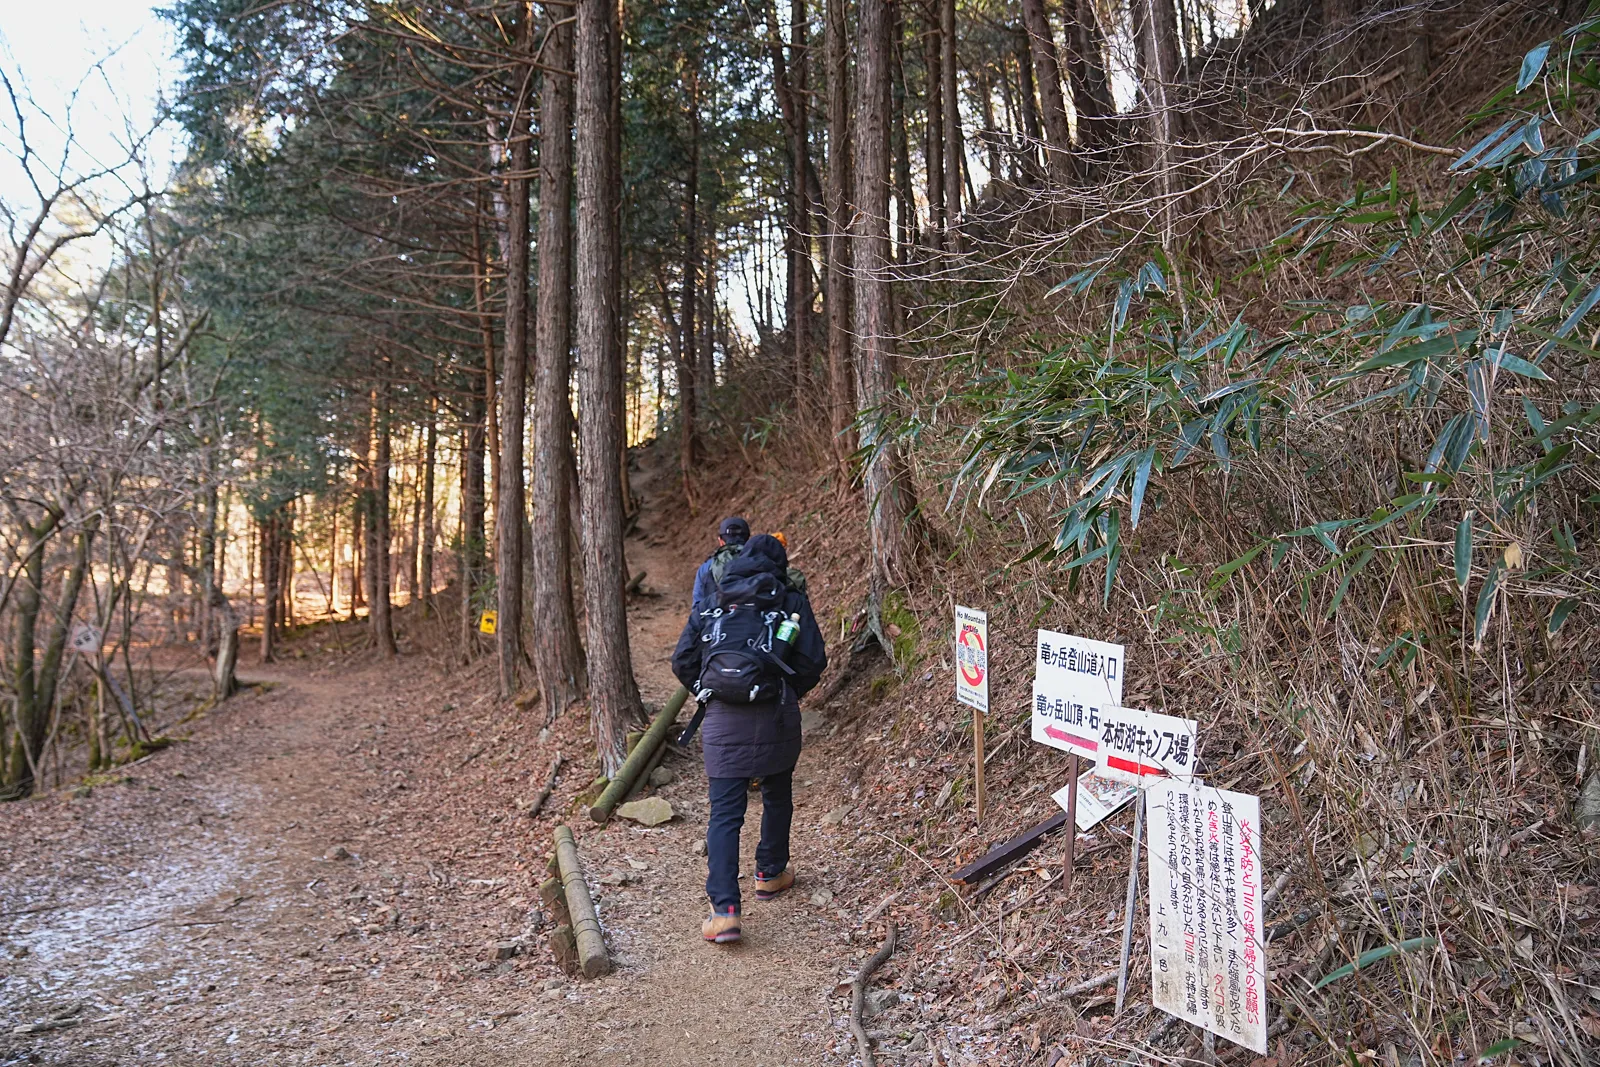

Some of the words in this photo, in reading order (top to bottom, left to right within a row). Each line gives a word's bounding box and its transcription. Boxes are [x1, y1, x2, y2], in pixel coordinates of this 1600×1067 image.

[964, 612, 985, 625] Mountain
[1040, 642, 1117, 681] 竜ヶ岳登山道入口
[1036, 693, 1101, 731] 竜ヶ岳山頂・石
[1101, 718, 1190, 766] 本栖湖キャンプ場
[1157, 904, 1169, 993] 上九一色村
